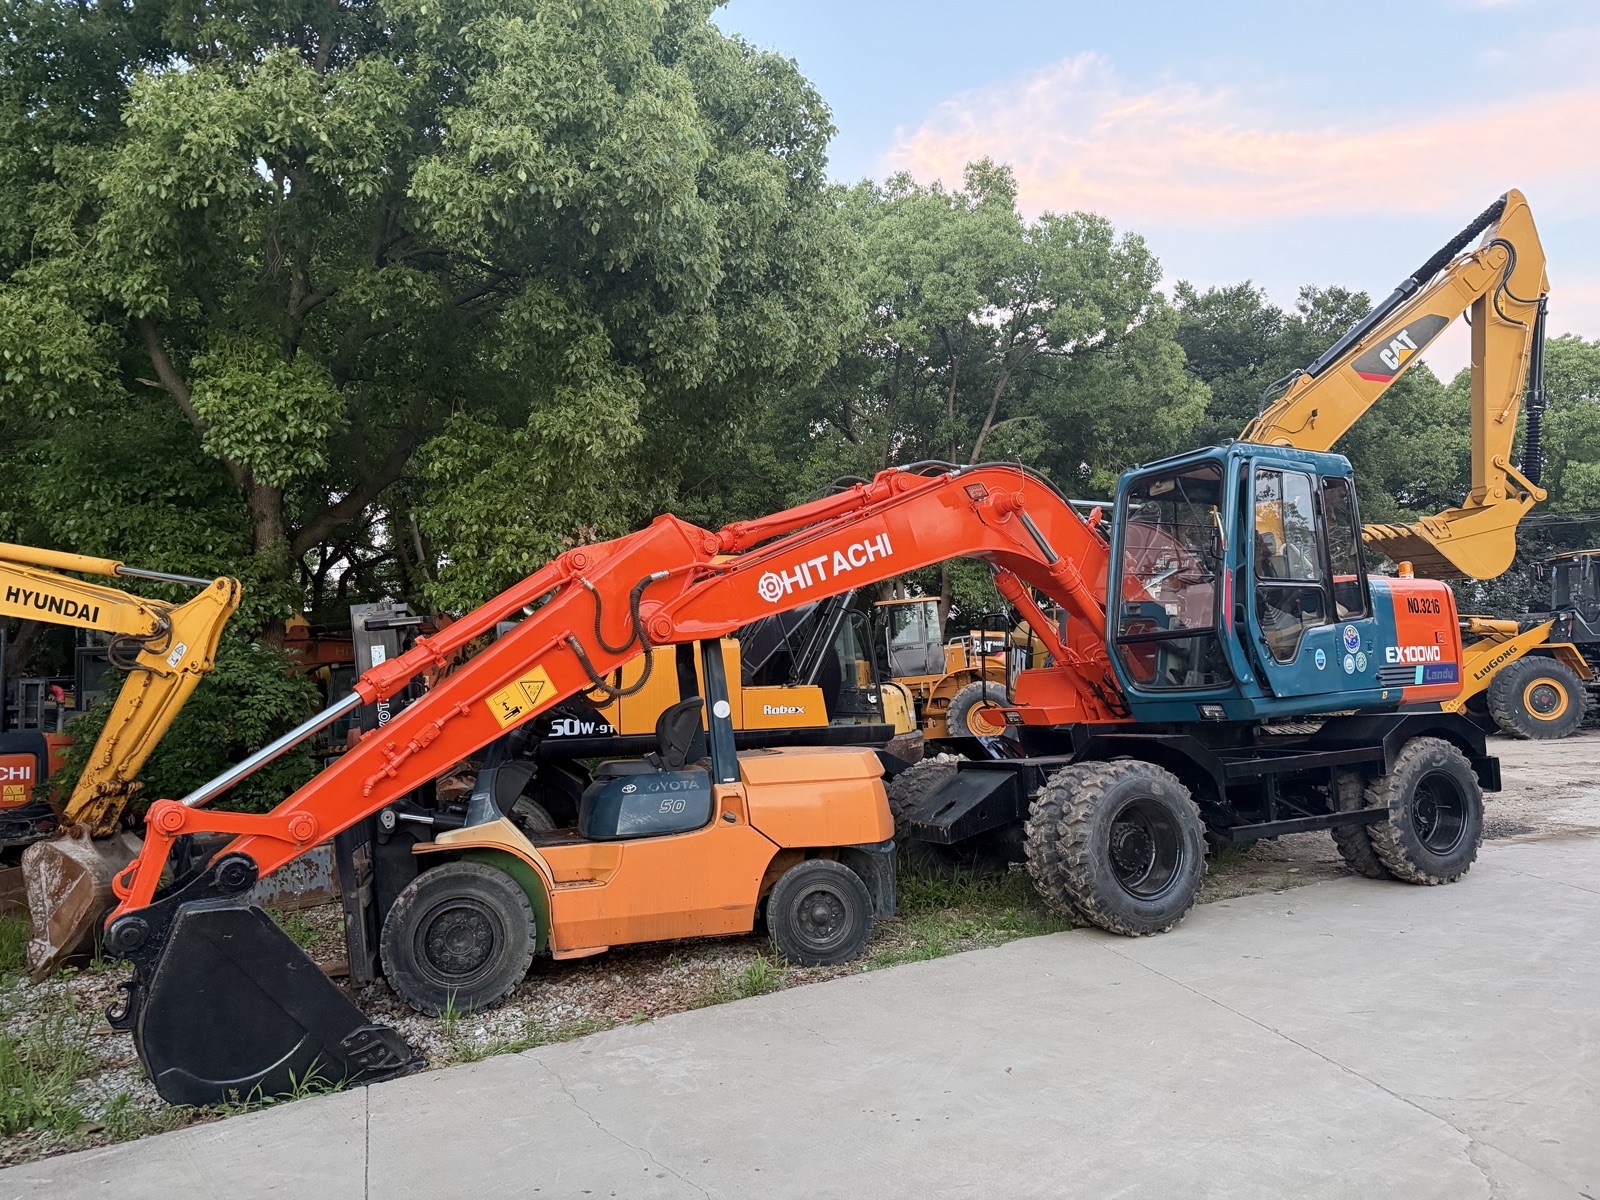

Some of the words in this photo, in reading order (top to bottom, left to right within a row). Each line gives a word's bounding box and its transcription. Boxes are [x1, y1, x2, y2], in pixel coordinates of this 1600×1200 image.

[1380, 329, 1418, 370] CAT
[780, 532, 893, 594] HITACHI
[6, 585, 100, 623] HYUNDAI
[1407, 598, 1440, 614] NO.3216
[658, 799, 686, 814] 50
